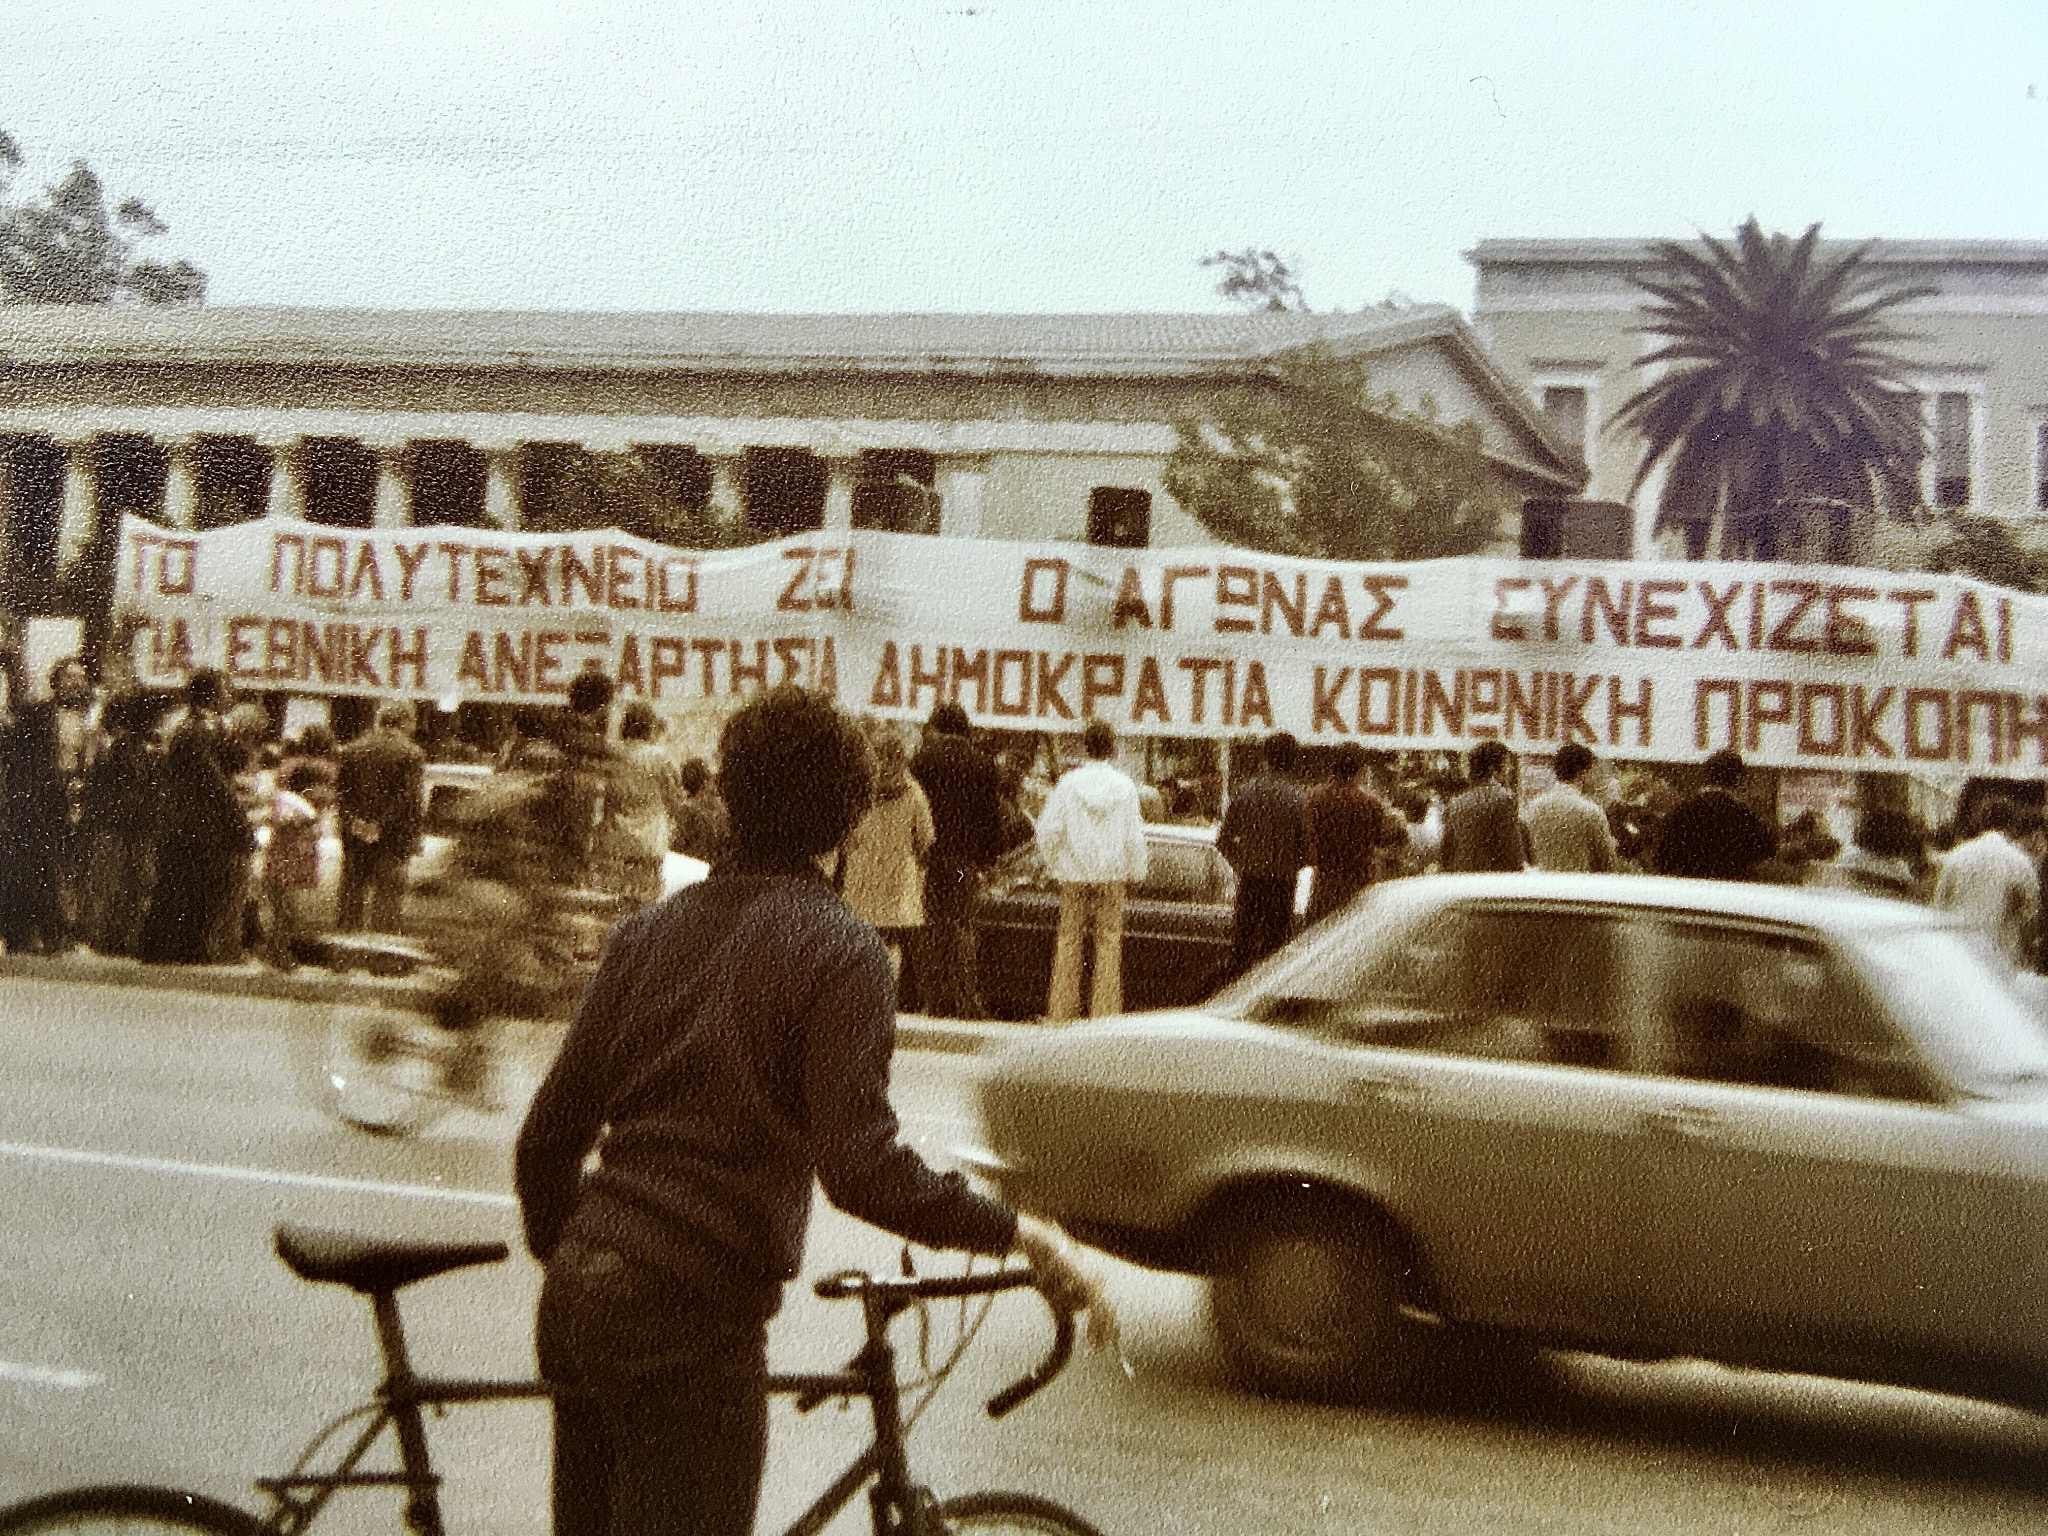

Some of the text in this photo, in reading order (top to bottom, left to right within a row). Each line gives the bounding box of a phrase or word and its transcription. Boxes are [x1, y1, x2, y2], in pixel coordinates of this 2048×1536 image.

[128, 533, 2012, 664] ΤΟ ΠΟΛΥΤΕΧΝΕΙΟ ΖΕΙ Ο ΑΓΩΝΑΣ ΣΥΝΕΧΙΖΕΤΑΙ
[870, 639, 1274, 728] ΔΗΜΟΚΡΑΤΙΑ
[1312, 665, 1653, 746] ΚΟΙΝΩΝΙΚΗ
